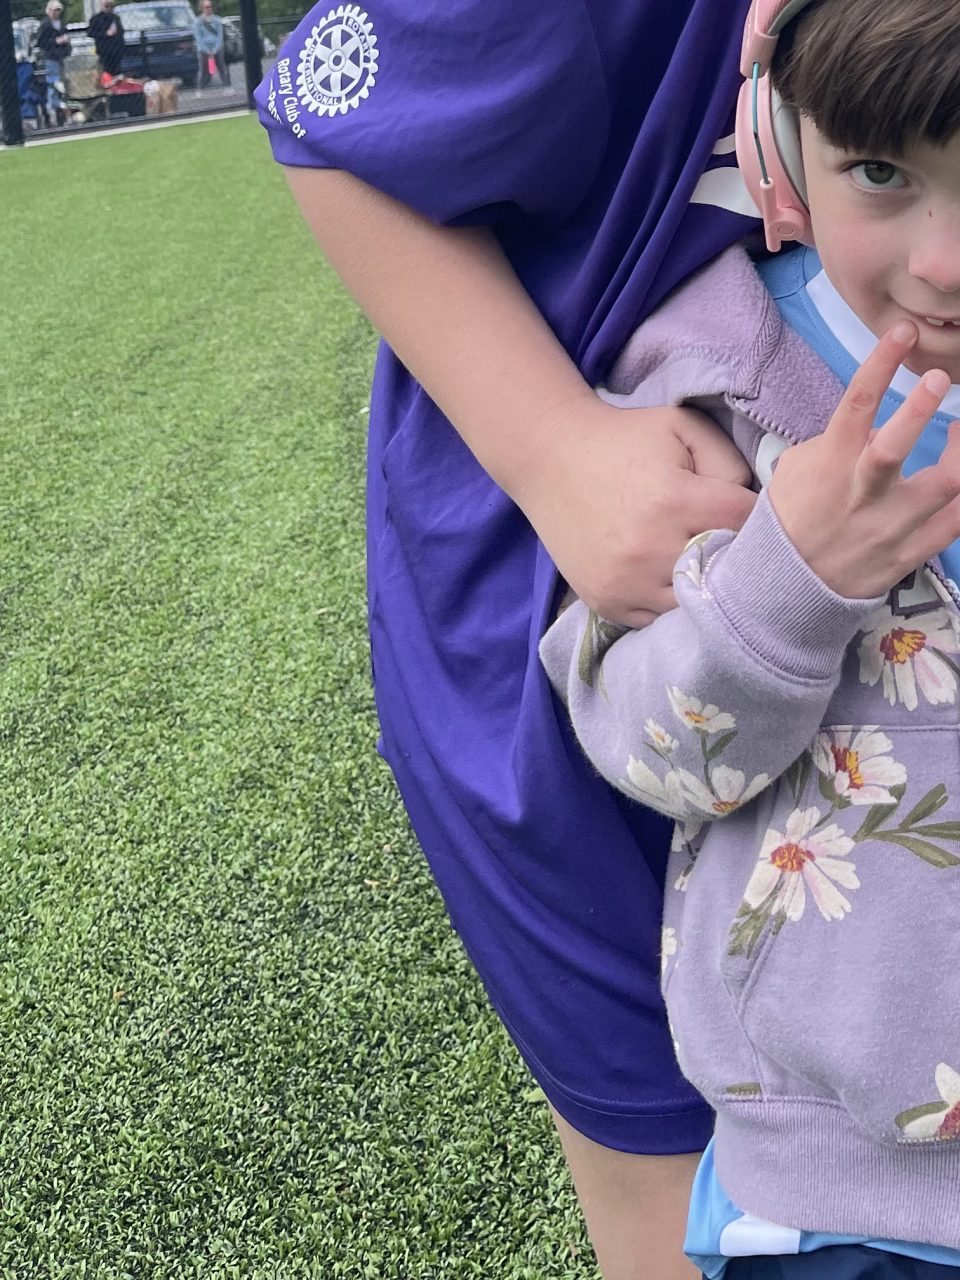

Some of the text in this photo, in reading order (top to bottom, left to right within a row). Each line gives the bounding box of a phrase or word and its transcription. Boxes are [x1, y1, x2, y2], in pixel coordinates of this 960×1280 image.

[348, 17, 371, 59] ROTARY
[276, 57, 307, 139] Rotary Club of
